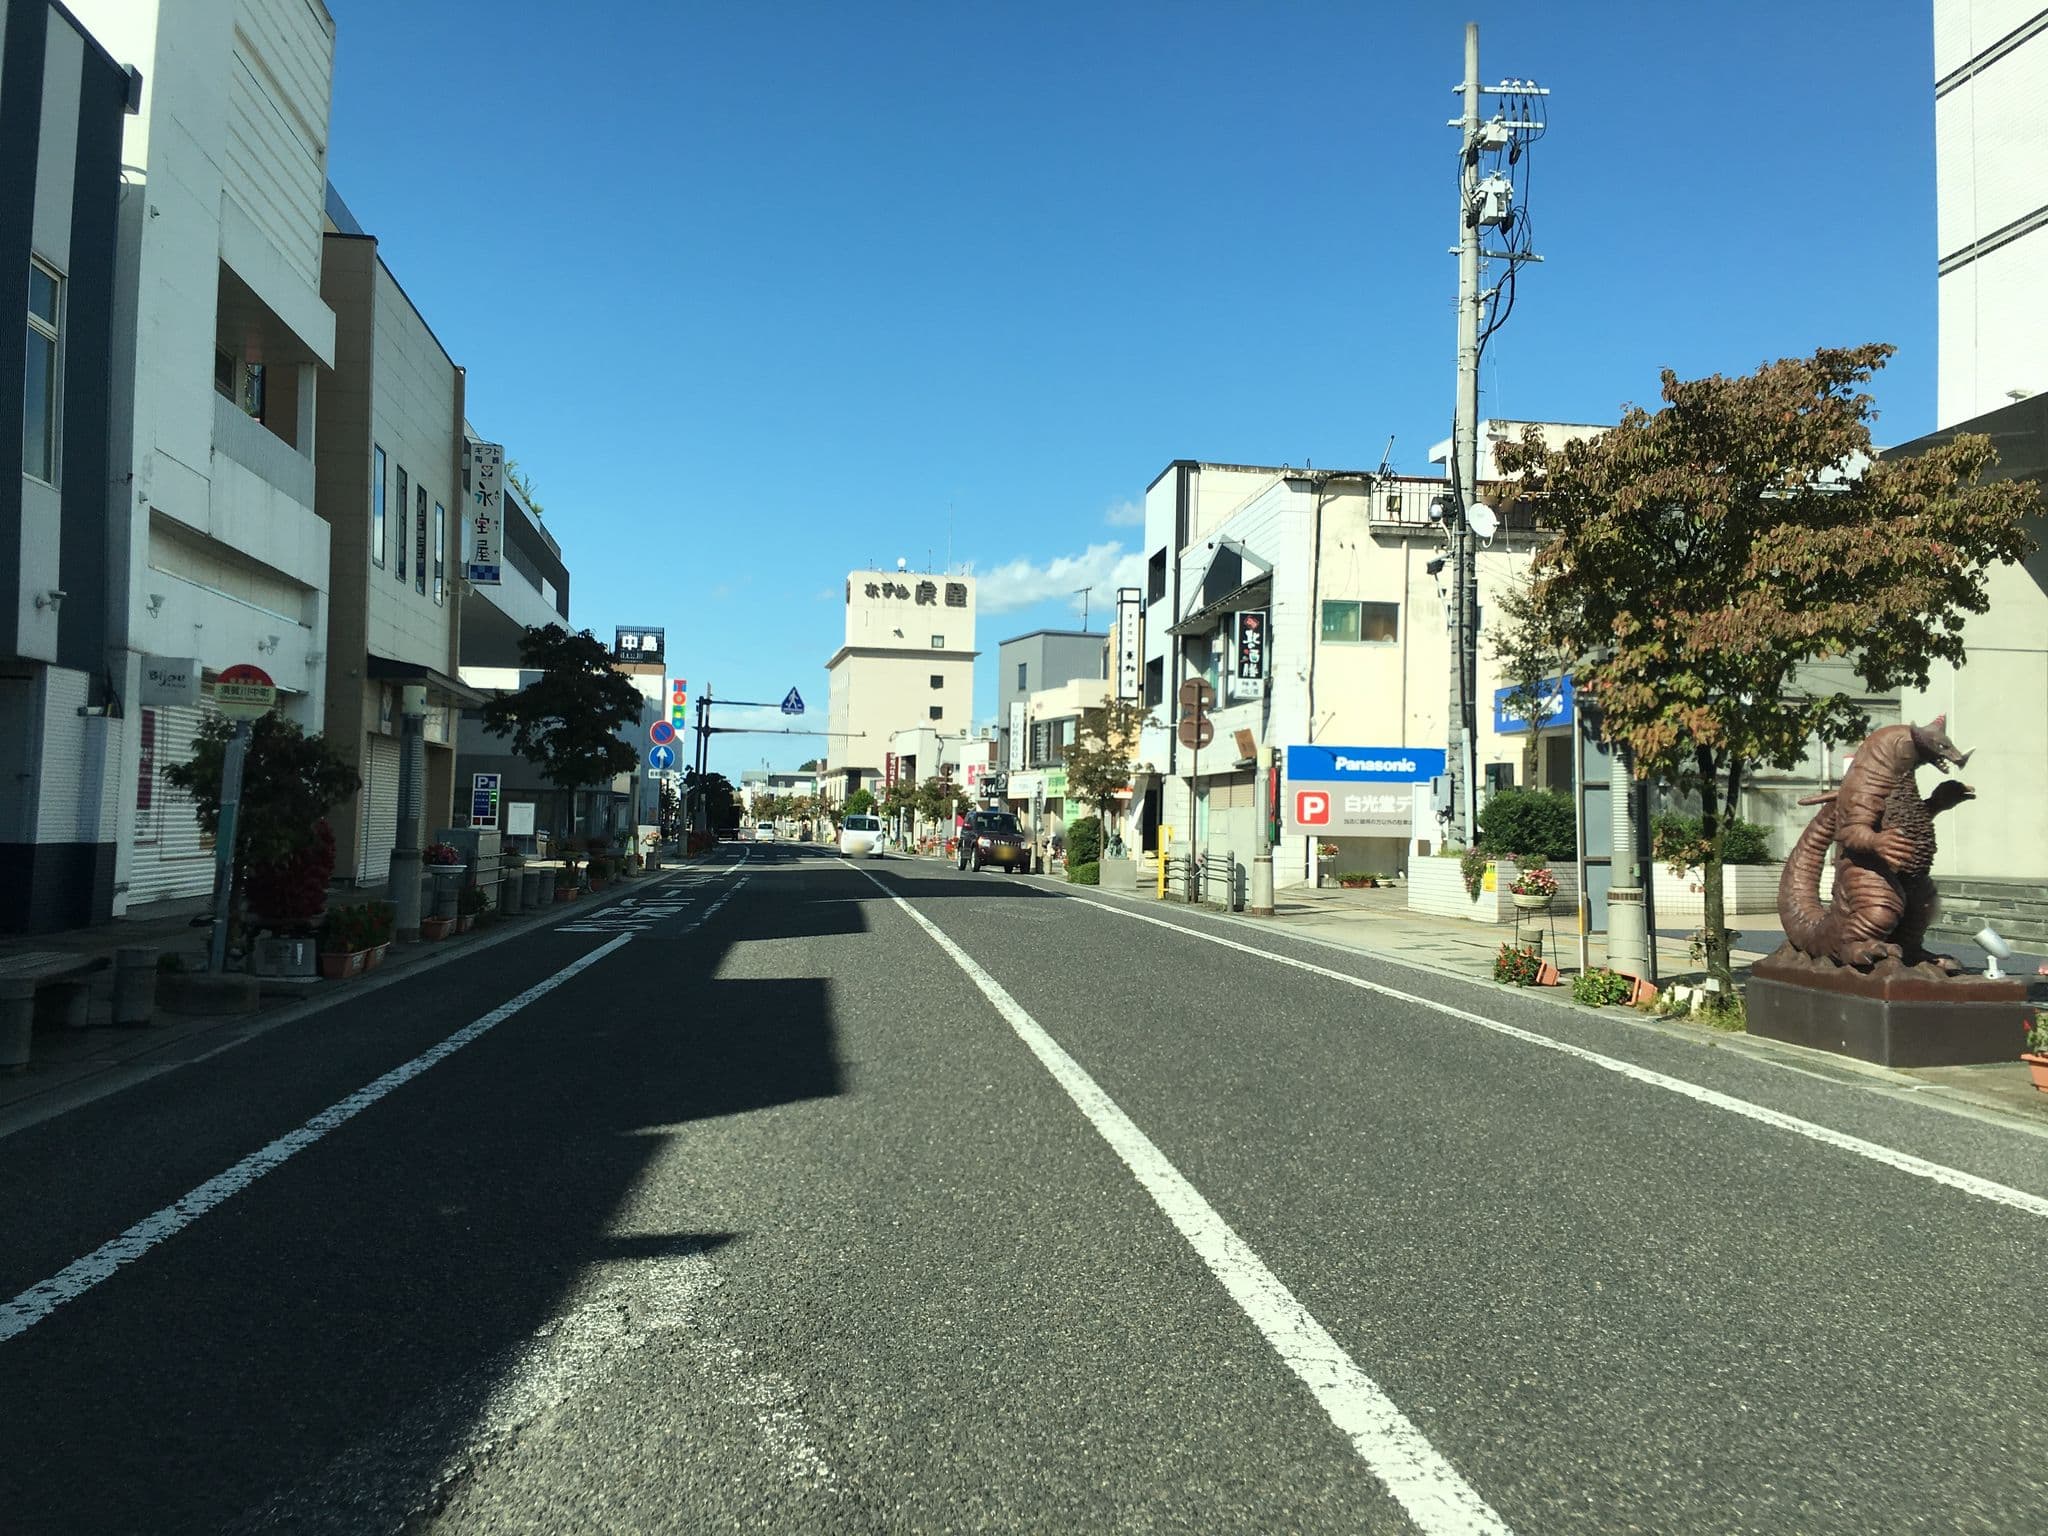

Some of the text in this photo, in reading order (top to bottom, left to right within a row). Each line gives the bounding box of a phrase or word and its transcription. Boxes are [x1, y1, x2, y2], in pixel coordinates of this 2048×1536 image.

[474, 447, 500, 455] ギフト
[622, 635, 657, 651] 中島
[1335, 756, 1417, 773] Panasonic
